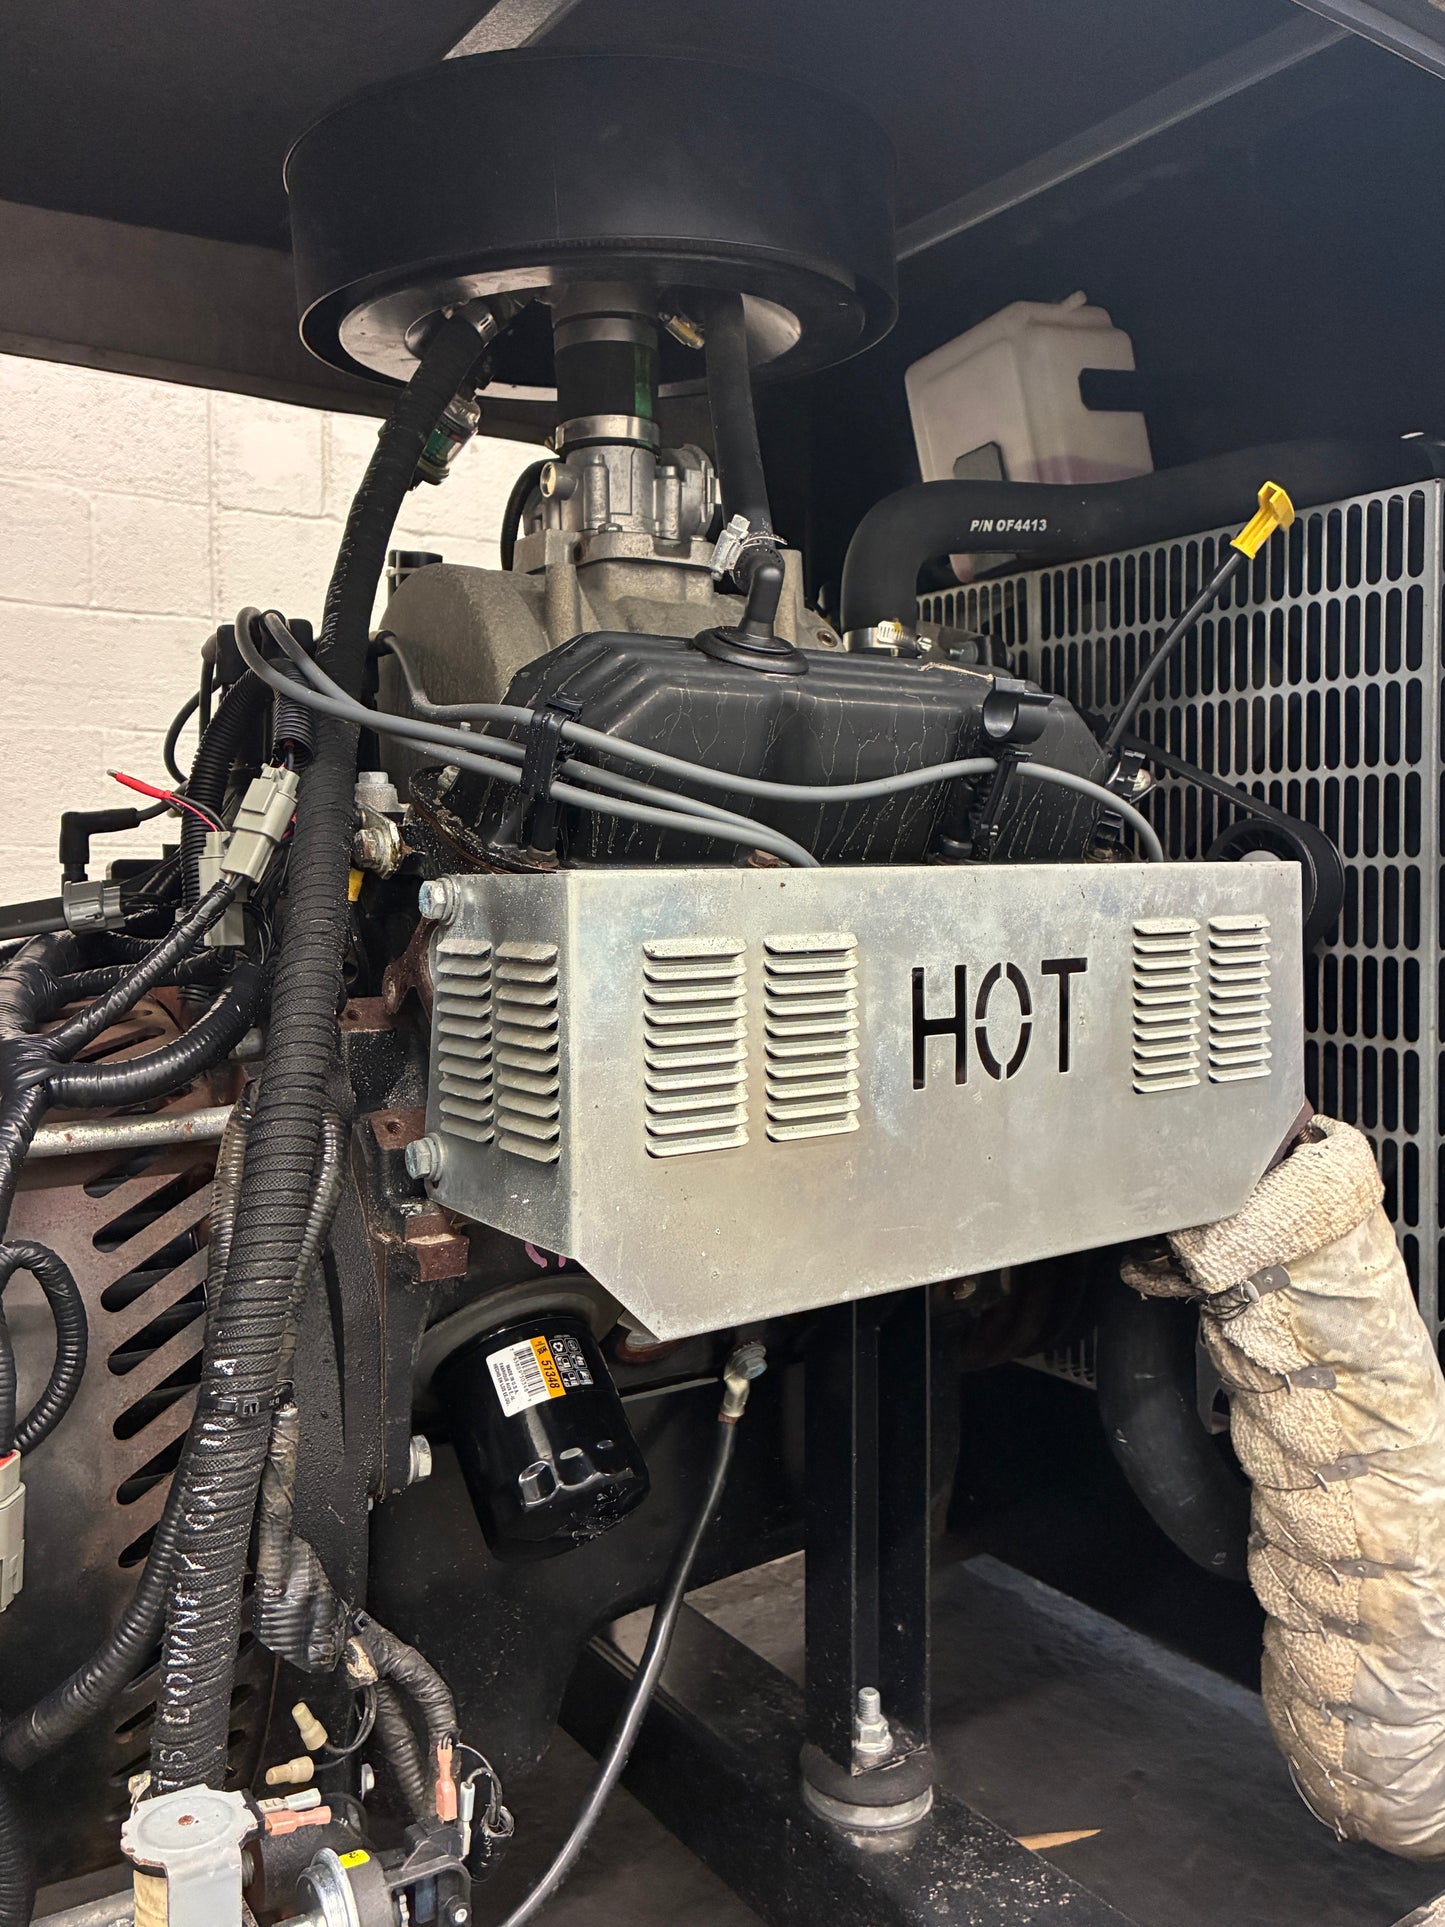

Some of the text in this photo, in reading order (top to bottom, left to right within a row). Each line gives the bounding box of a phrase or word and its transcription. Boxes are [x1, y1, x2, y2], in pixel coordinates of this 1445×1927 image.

[969, 519, 994, 532] P/N
[912, 957, 1088, 1090] HOT
[493, 1363, 501, 1377] HECHO
[541, 1360, 560, 1388] 51348
